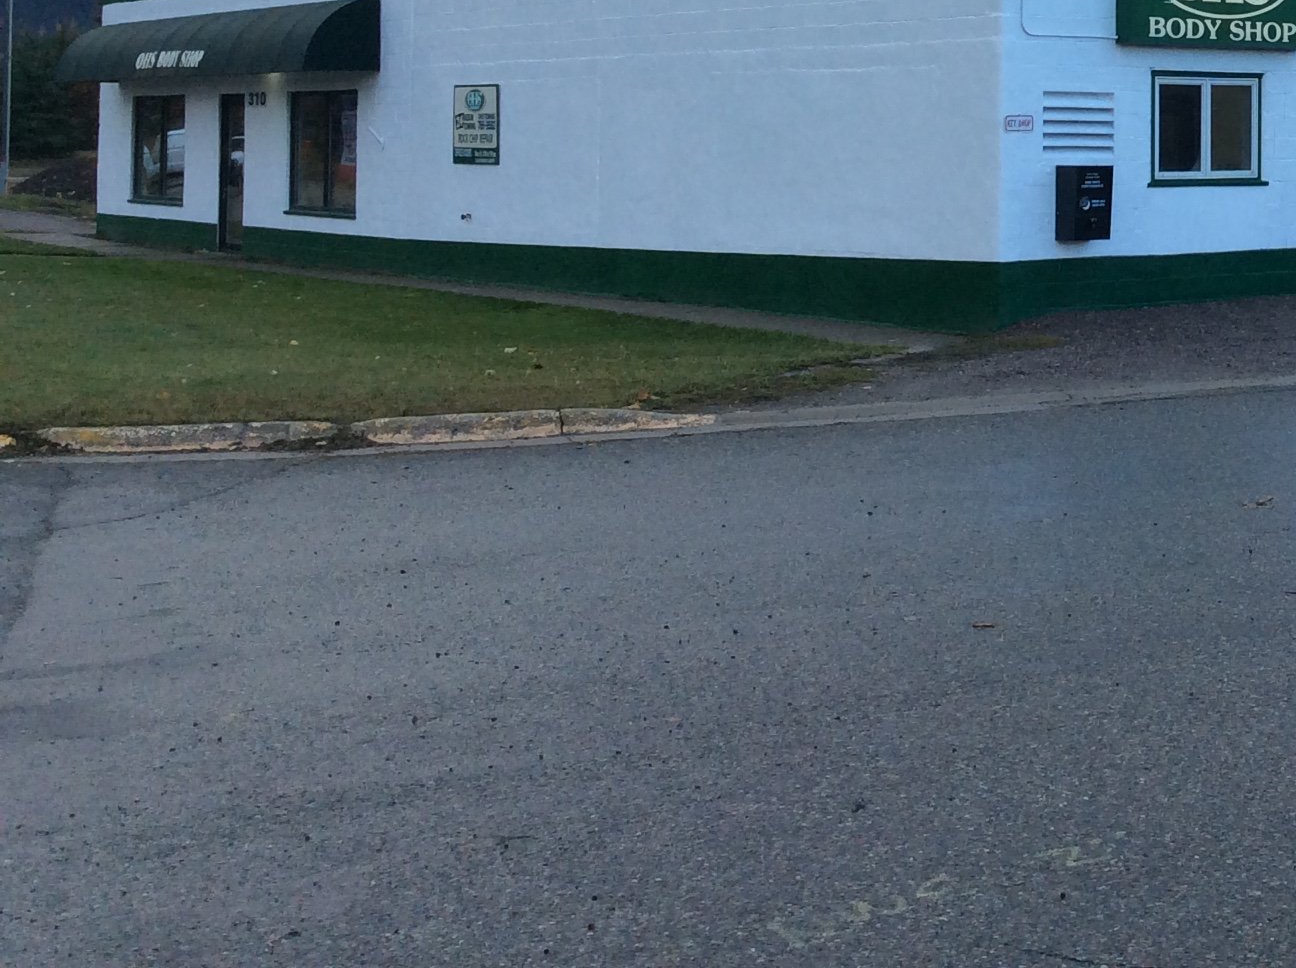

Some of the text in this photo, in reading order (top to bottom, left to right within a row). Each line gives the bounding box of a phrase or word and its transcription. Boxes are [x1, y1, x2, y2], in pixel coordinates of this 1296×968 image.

[1148, 16, 1221, 40] BODY
[179, 50, 205, 68] SHOP
[248, 92, 266, 105] 310
